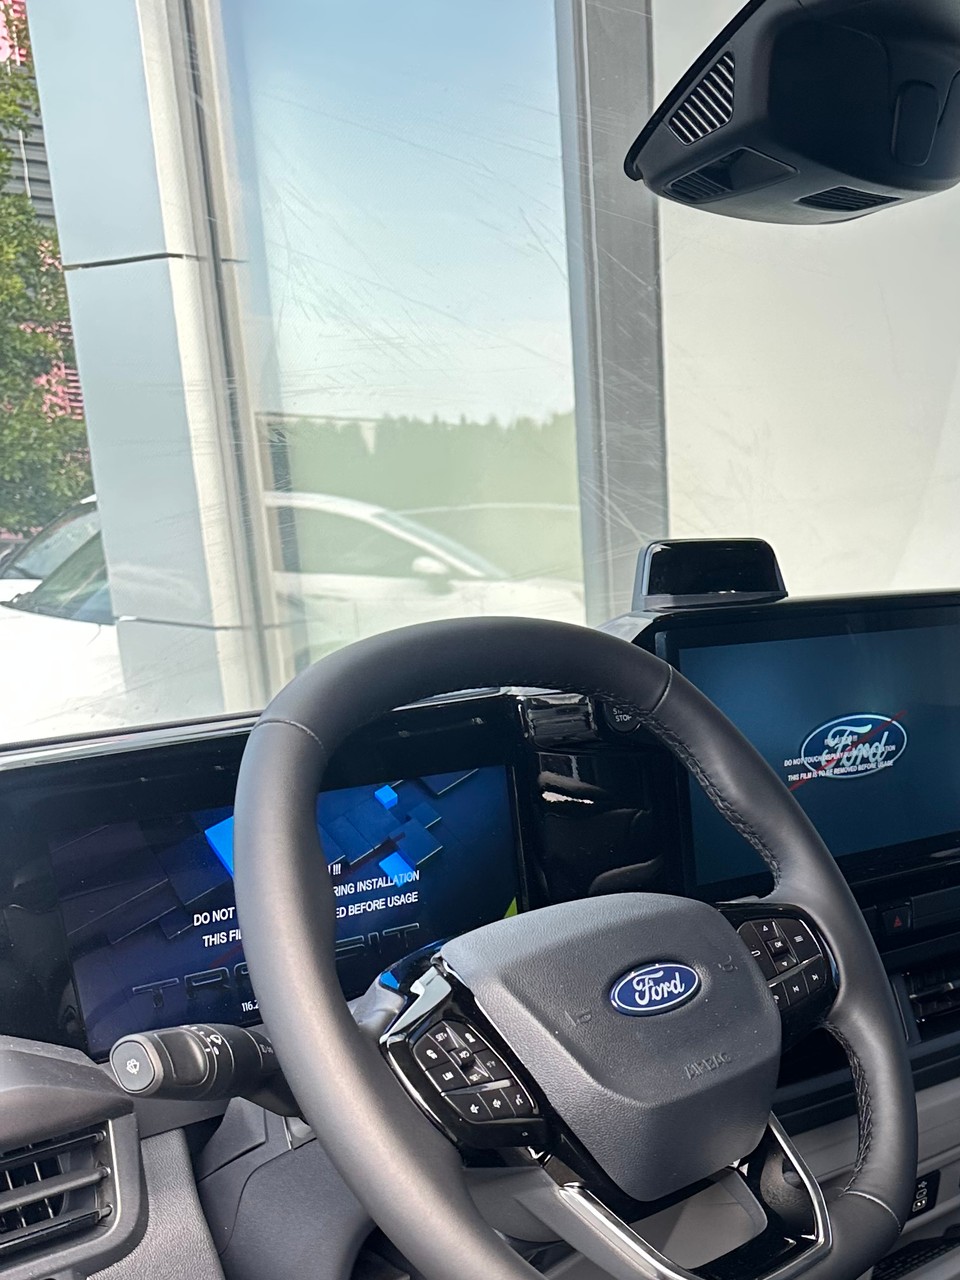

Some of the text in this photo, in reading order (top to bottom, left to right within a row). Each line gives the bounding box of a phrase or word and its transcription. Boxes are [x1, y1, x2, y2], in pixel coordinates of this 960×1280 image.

[821, 723, 889, 768] Ford
[193, 912, 211, 927] DO
[212, 906, 236, 923] NOT
[356, 869, 420, 893] INSTALLATION
[202, 932, 228, 948] THIS
[348, 898, 386, 917] BEFORE
[387, 891, 419, 908] USAGE
[774, 940, 784, 948] OK
[632, 970, 685, 1005] Ford
